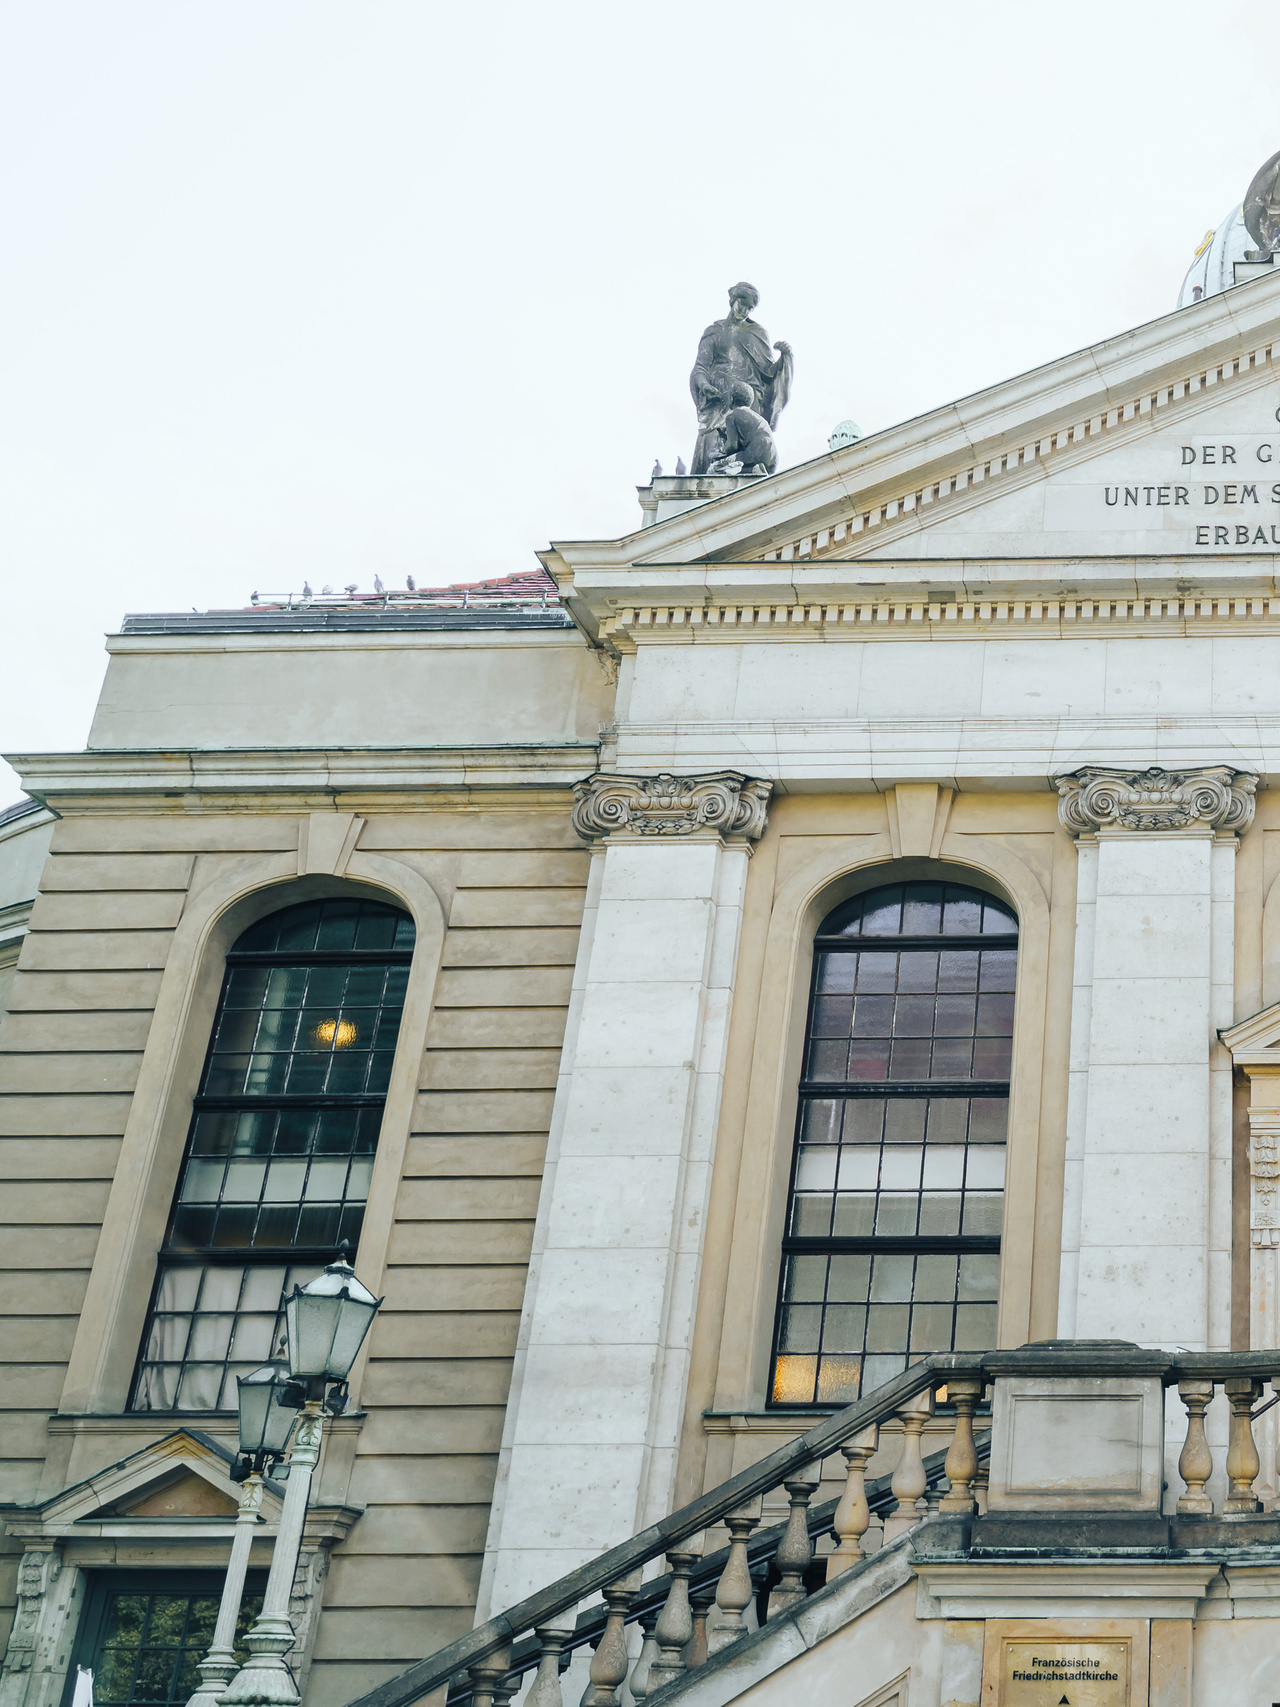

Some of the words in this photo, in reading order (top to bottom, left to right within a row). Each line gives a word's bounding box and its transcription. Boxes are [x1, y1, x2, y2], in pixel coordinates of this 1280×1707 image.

[1181, 445, 1237, 466] DER
[1104, 486, 1190, 507] UNTER
[1203, 484, 1259, 505] DEM
[1031, 1657, 1100, 1668] Französische
[1012, 1670, 1119, 1681] Friedrichstadtkirche
